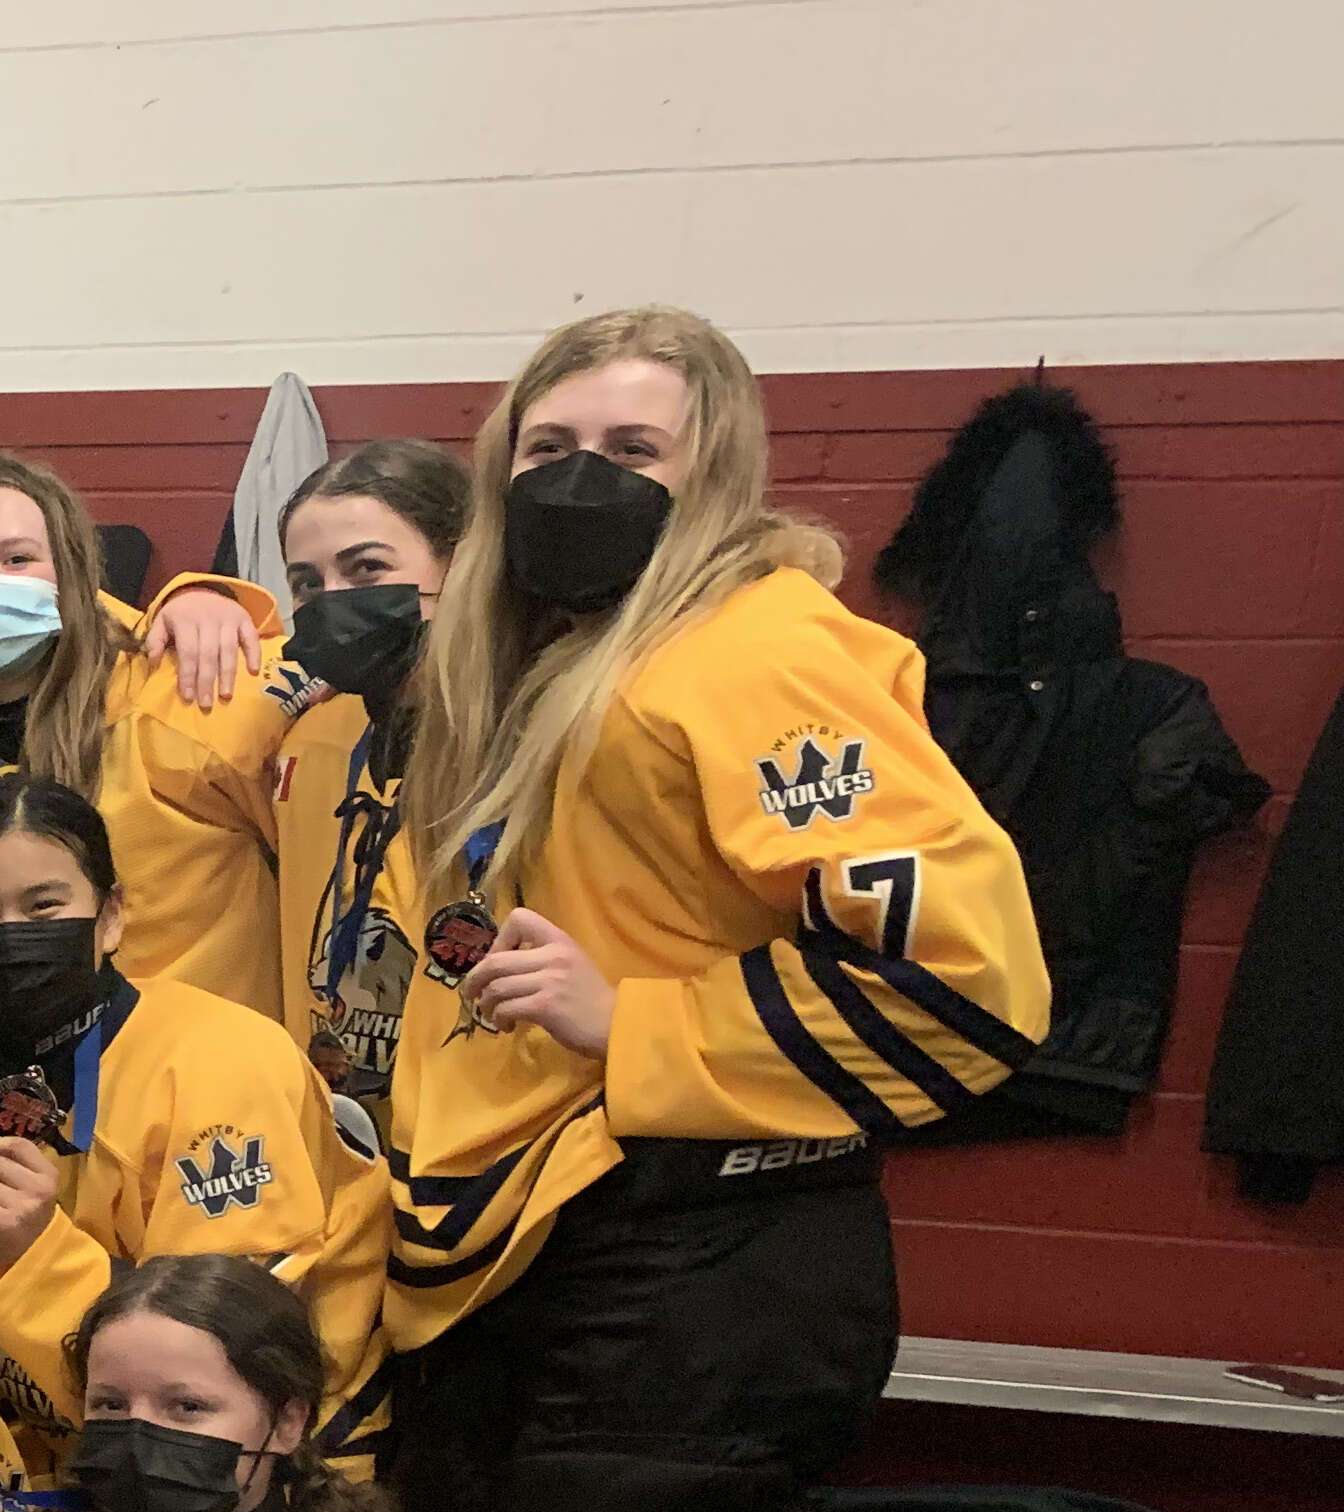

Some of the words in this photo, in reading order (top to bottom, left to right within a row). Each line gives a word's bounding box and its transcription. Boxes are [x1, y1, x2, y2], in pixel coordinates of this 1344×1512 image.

[771, 723, 844, 752] WHITBY
[760, 770, 874, 814] WOLVES
[187, 1124, 246, 1153] WHITBY
[180, 1161, 272, 1205] WOLVES
